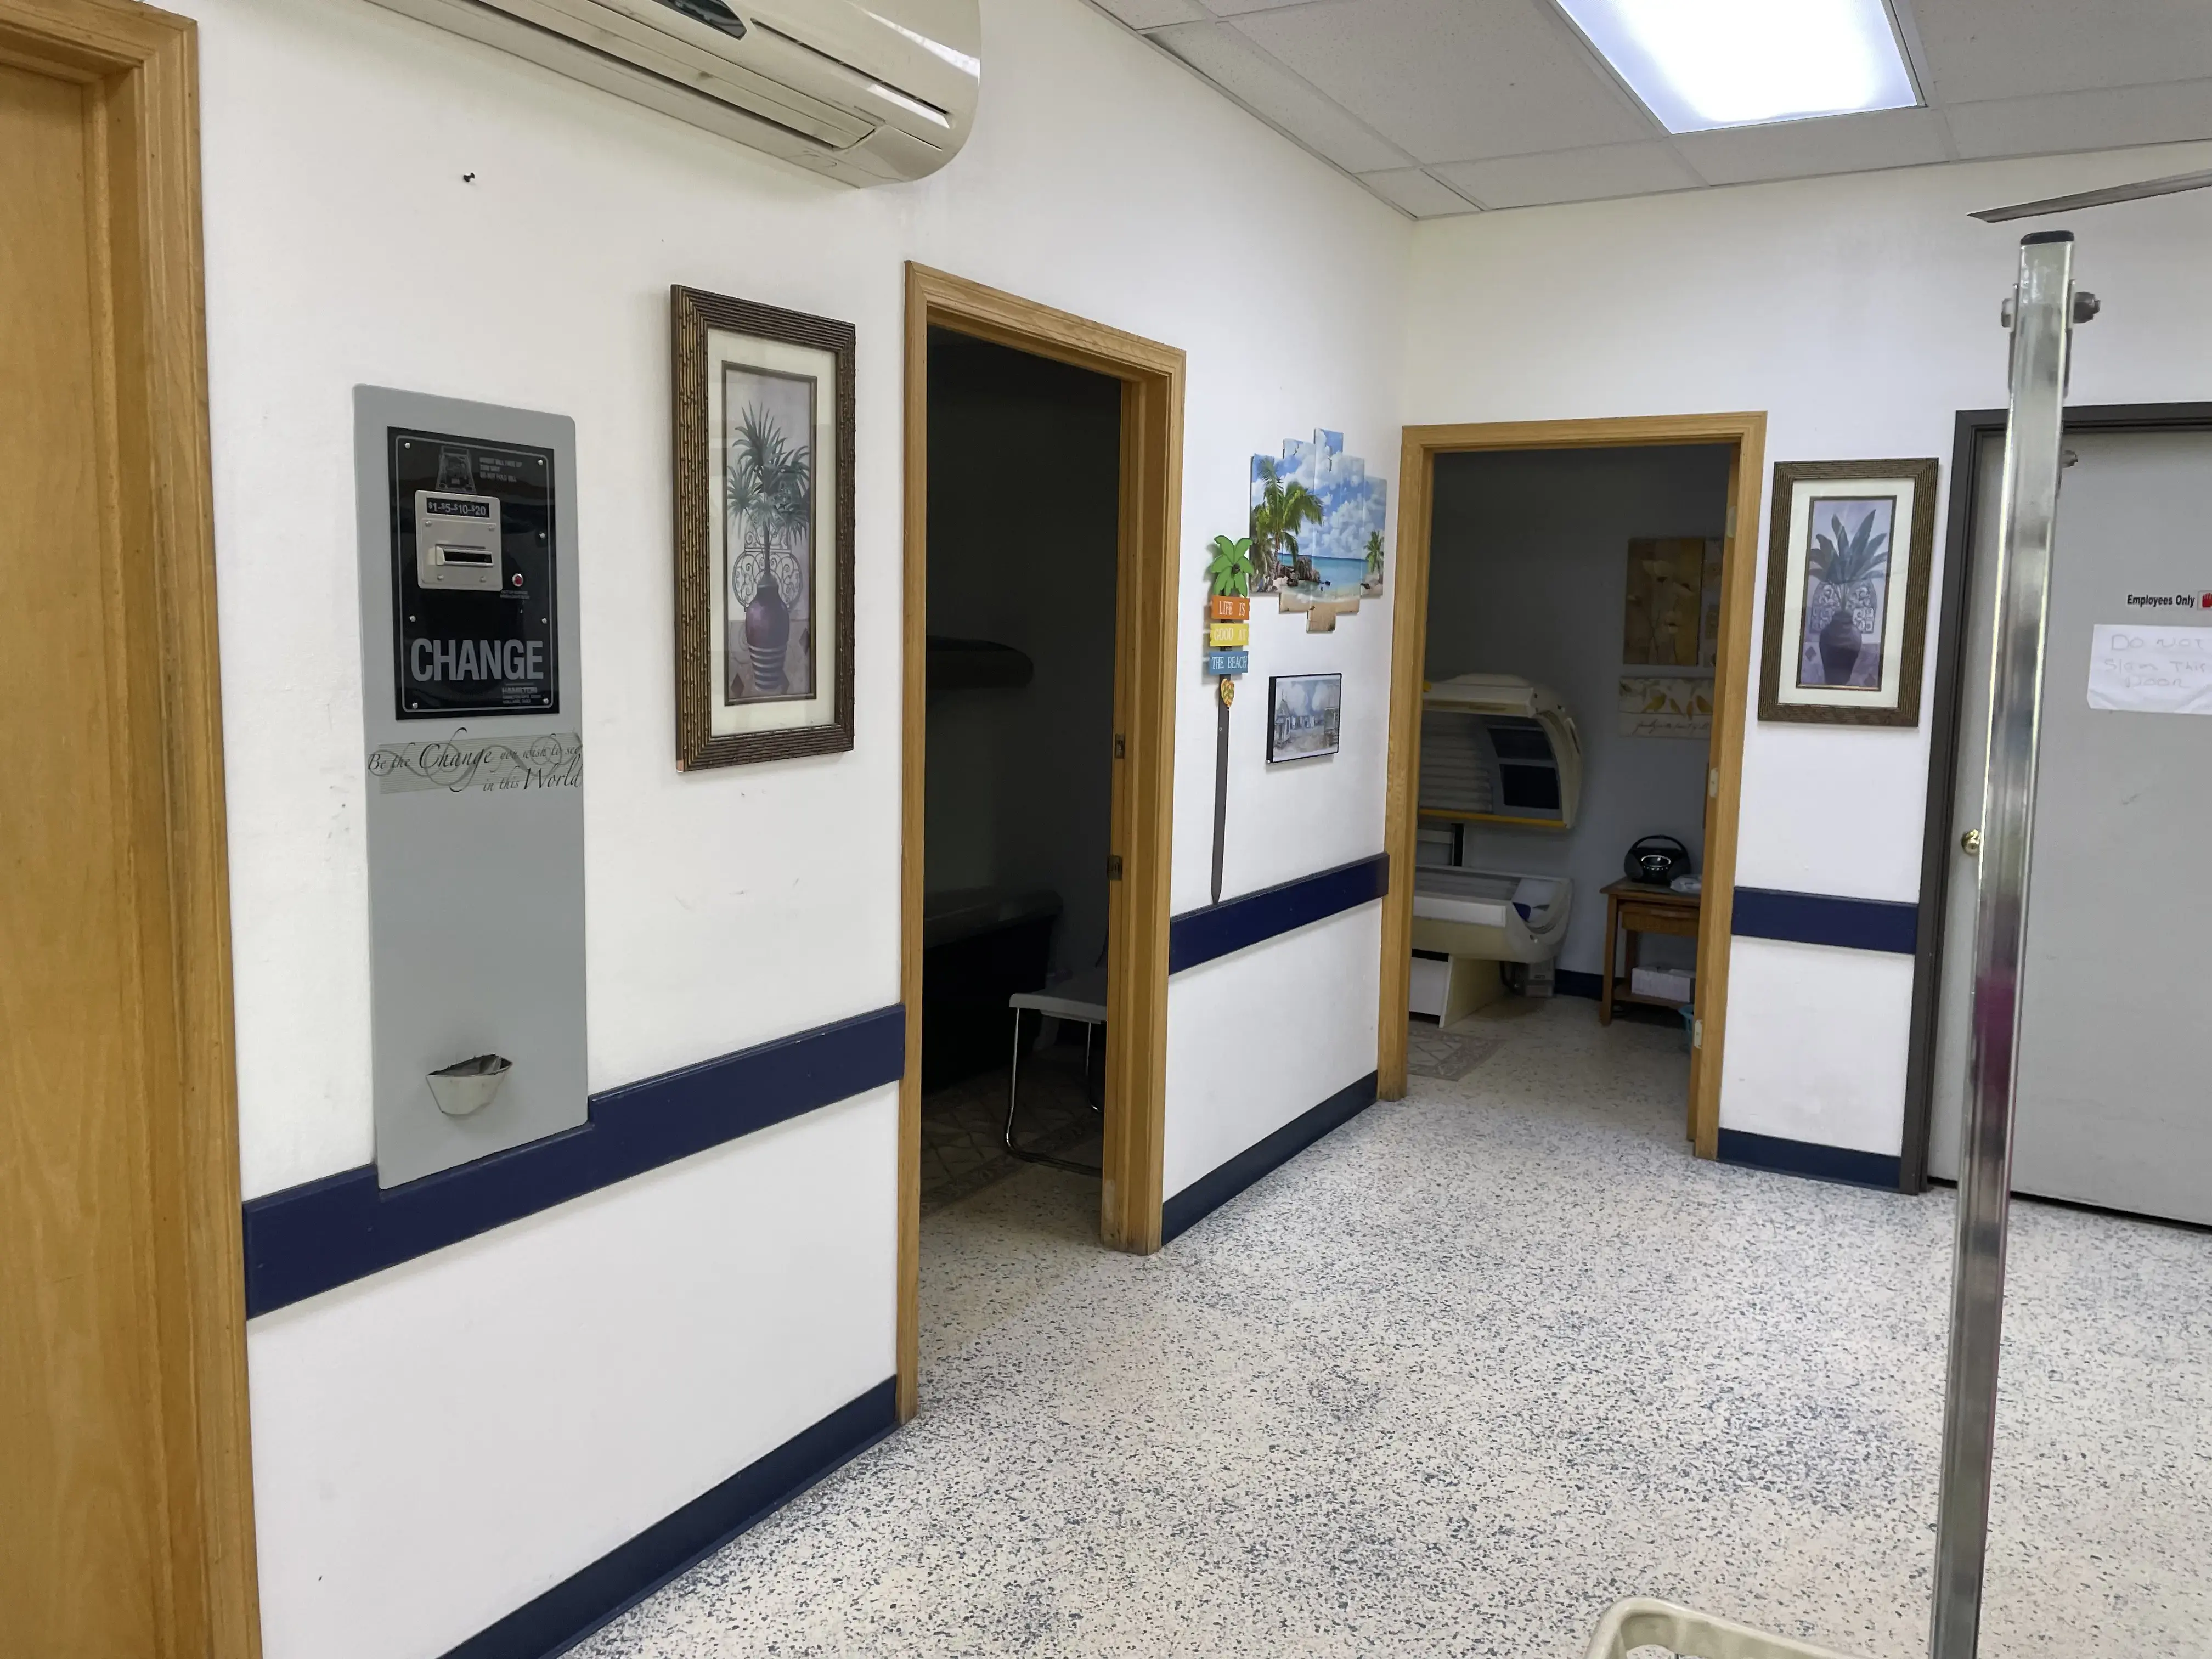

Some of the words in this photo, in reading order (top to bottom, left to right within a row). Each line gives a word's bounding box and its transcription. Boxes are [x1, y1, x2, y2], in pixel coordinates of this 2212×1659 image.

[1219, 601, 1233, 616] LIFE
[1239, 602, 1246, 616] IS
[2127, 594, 2173, 608] Employees
[2176, 594, 2195, 608] Only
[1214, 627, 1234, 641] GOOD
[1238, 629, 1246, 641] AT
[411, 638, 544, 681] CHANGE
[1211, 657, 1224, 669] THE
[1228, 656, 1248, 669] BEACH
[368, 753, 386, 770] Be
[391, 744, 415, 768] the
[419, 727, 492, 792] Change
[483, 778, 494, 791] in
[499, 768, 520, 790] this
[523, 753, 583, 790] World
